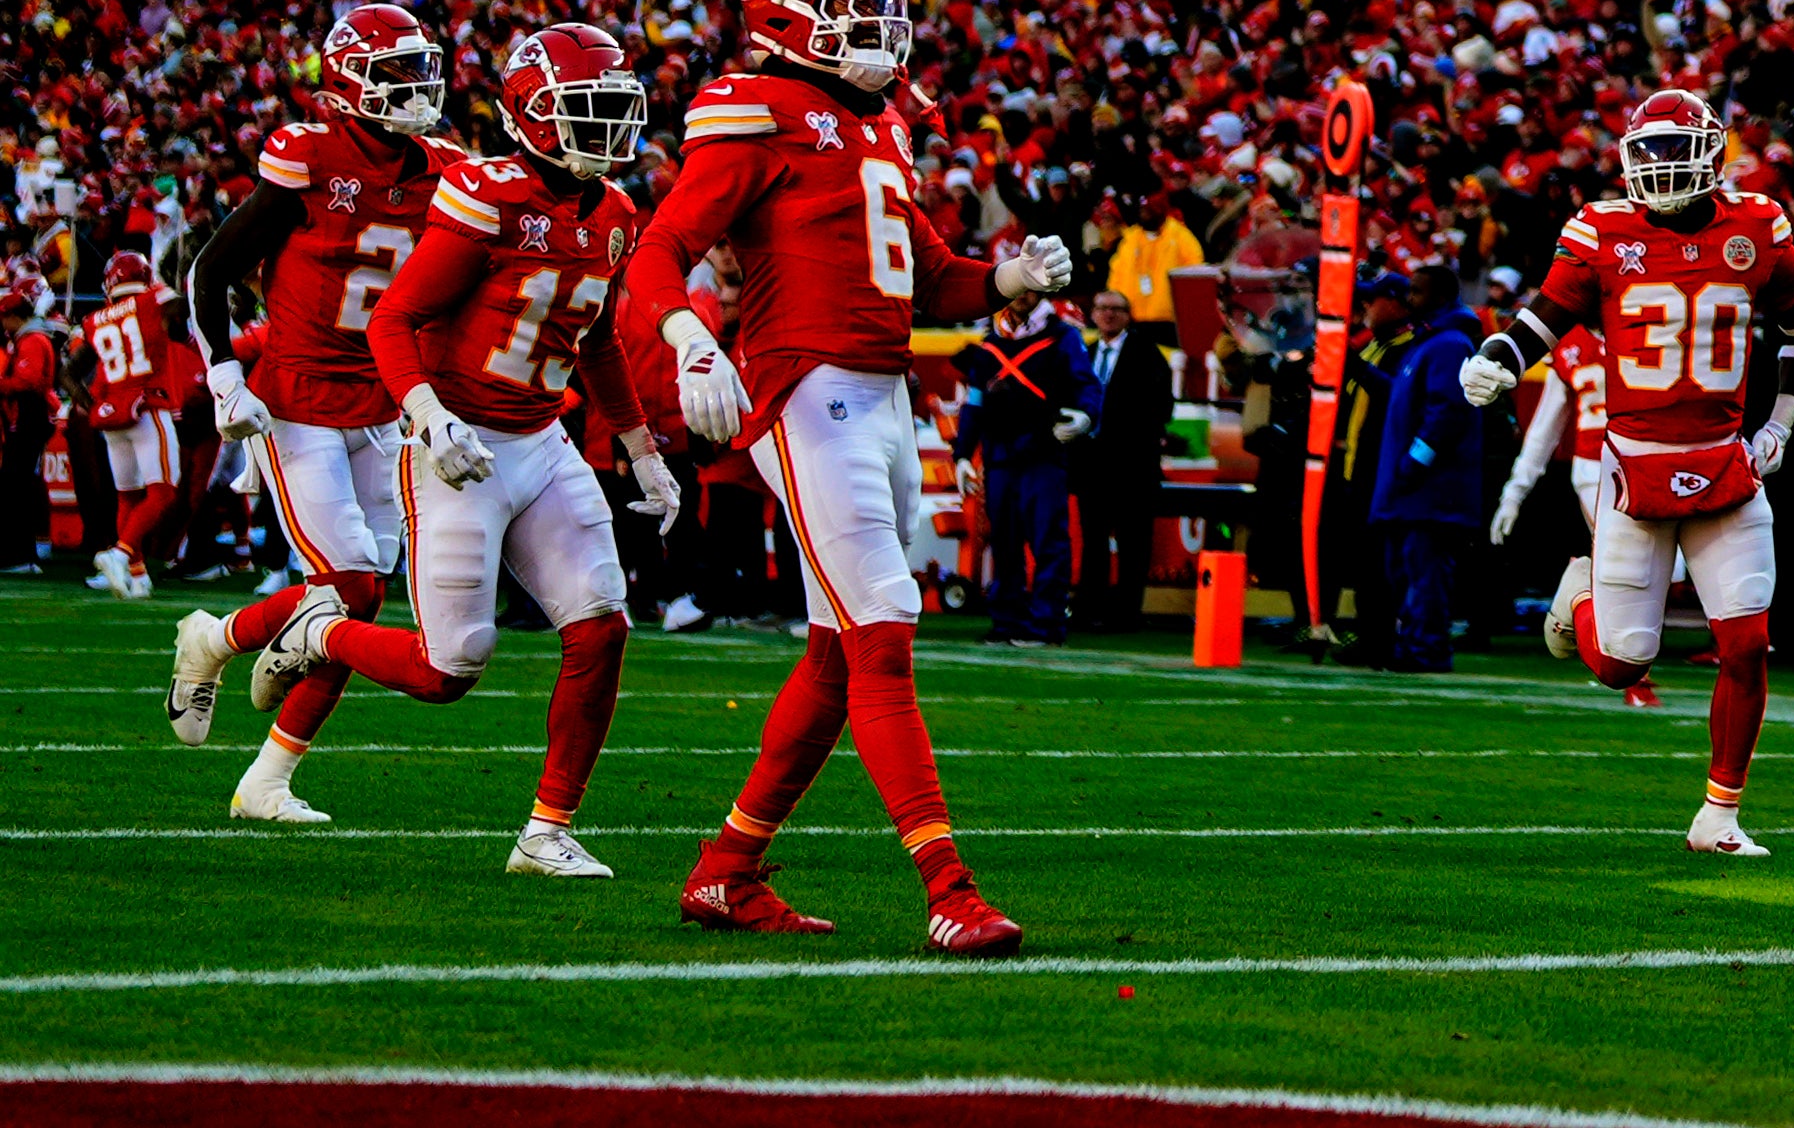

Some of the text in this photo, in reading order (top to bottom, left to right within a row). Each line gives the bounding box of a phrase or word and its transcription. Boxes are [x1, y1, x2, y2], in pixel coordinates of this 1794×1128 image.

[859, 157, 914, 299] 6
[93, 314, 153, 384] 81
[482, 267, 610, 391] 13
[1618, 282, 1752, 392] 30
